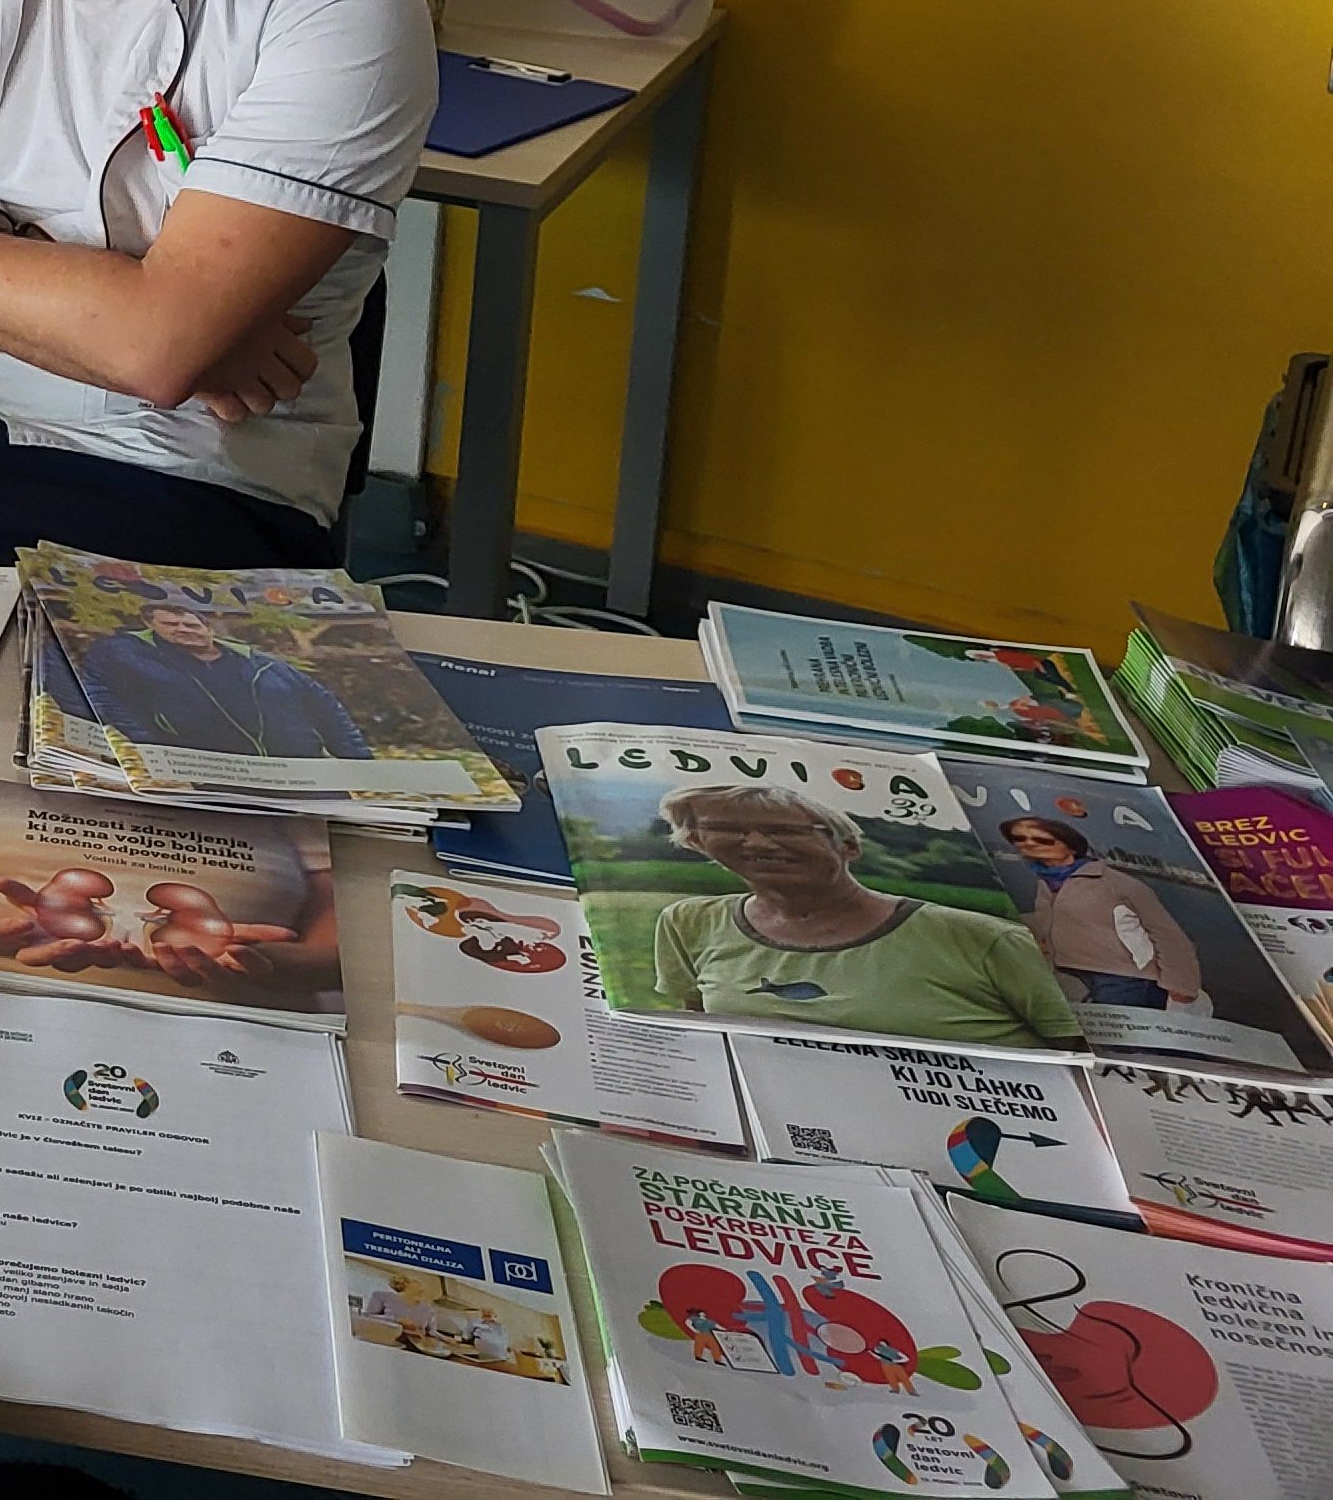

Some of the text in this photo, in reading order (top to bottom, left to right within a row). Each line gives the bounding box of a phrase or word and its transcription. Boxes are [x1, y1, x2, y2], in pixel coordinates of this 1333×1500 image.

[27, 810, 255, 851] Možnosti zdravljenja,
[1195, 816, 1273, 832] BREZ
[28, 821, 41, 831] ki
[83, 830, 108, 840] na
[115, 834, 165, 848] voljo
[171, 840, 254, 861] bolniku
[1204, 829, 1309, 846] LEDVIC
[40, 834, 103, 849] končno
[108, 844, 197, 865] odpovedjo
[202, 855, 256, 872] ledvic
[93, 1063, 127, 1079] 20
[468, 1056, 525, 1073] Svetovni
[501, 1070, 525, 1080] dan
[487, 1079, 527, 1094] ledvic
[890, 1065, 1045, 1100] KI JO LAHKO
[898, 1086, 1057, 1121] TUDI SLEČEMO
[633, 1166, 851, 1213] ZA POČASNEJŠE
[640, 1182, 861, 1234] STARANJE
[644, 1202, 869, 1251] POSKRBITE ZA
[373, 1232, 452, 1254] PERITONEALNA
[649, 1219, 881, 1280] LEDVICE
[421, 1256, 464, 1270] DIALIZA
[1186, 1274, 1301, 1304] Kronična
[1194, 1291, 1304, 1320] ledvična
[1202, 1308, 1305, 1337] bolezen
[902, 1413, 955, 1437] 20
[906, 1444, 975, 1459] Svetovni
[911, 1454, 940, 1464] dan
[914, 1464, 963, 1475] ledvic
